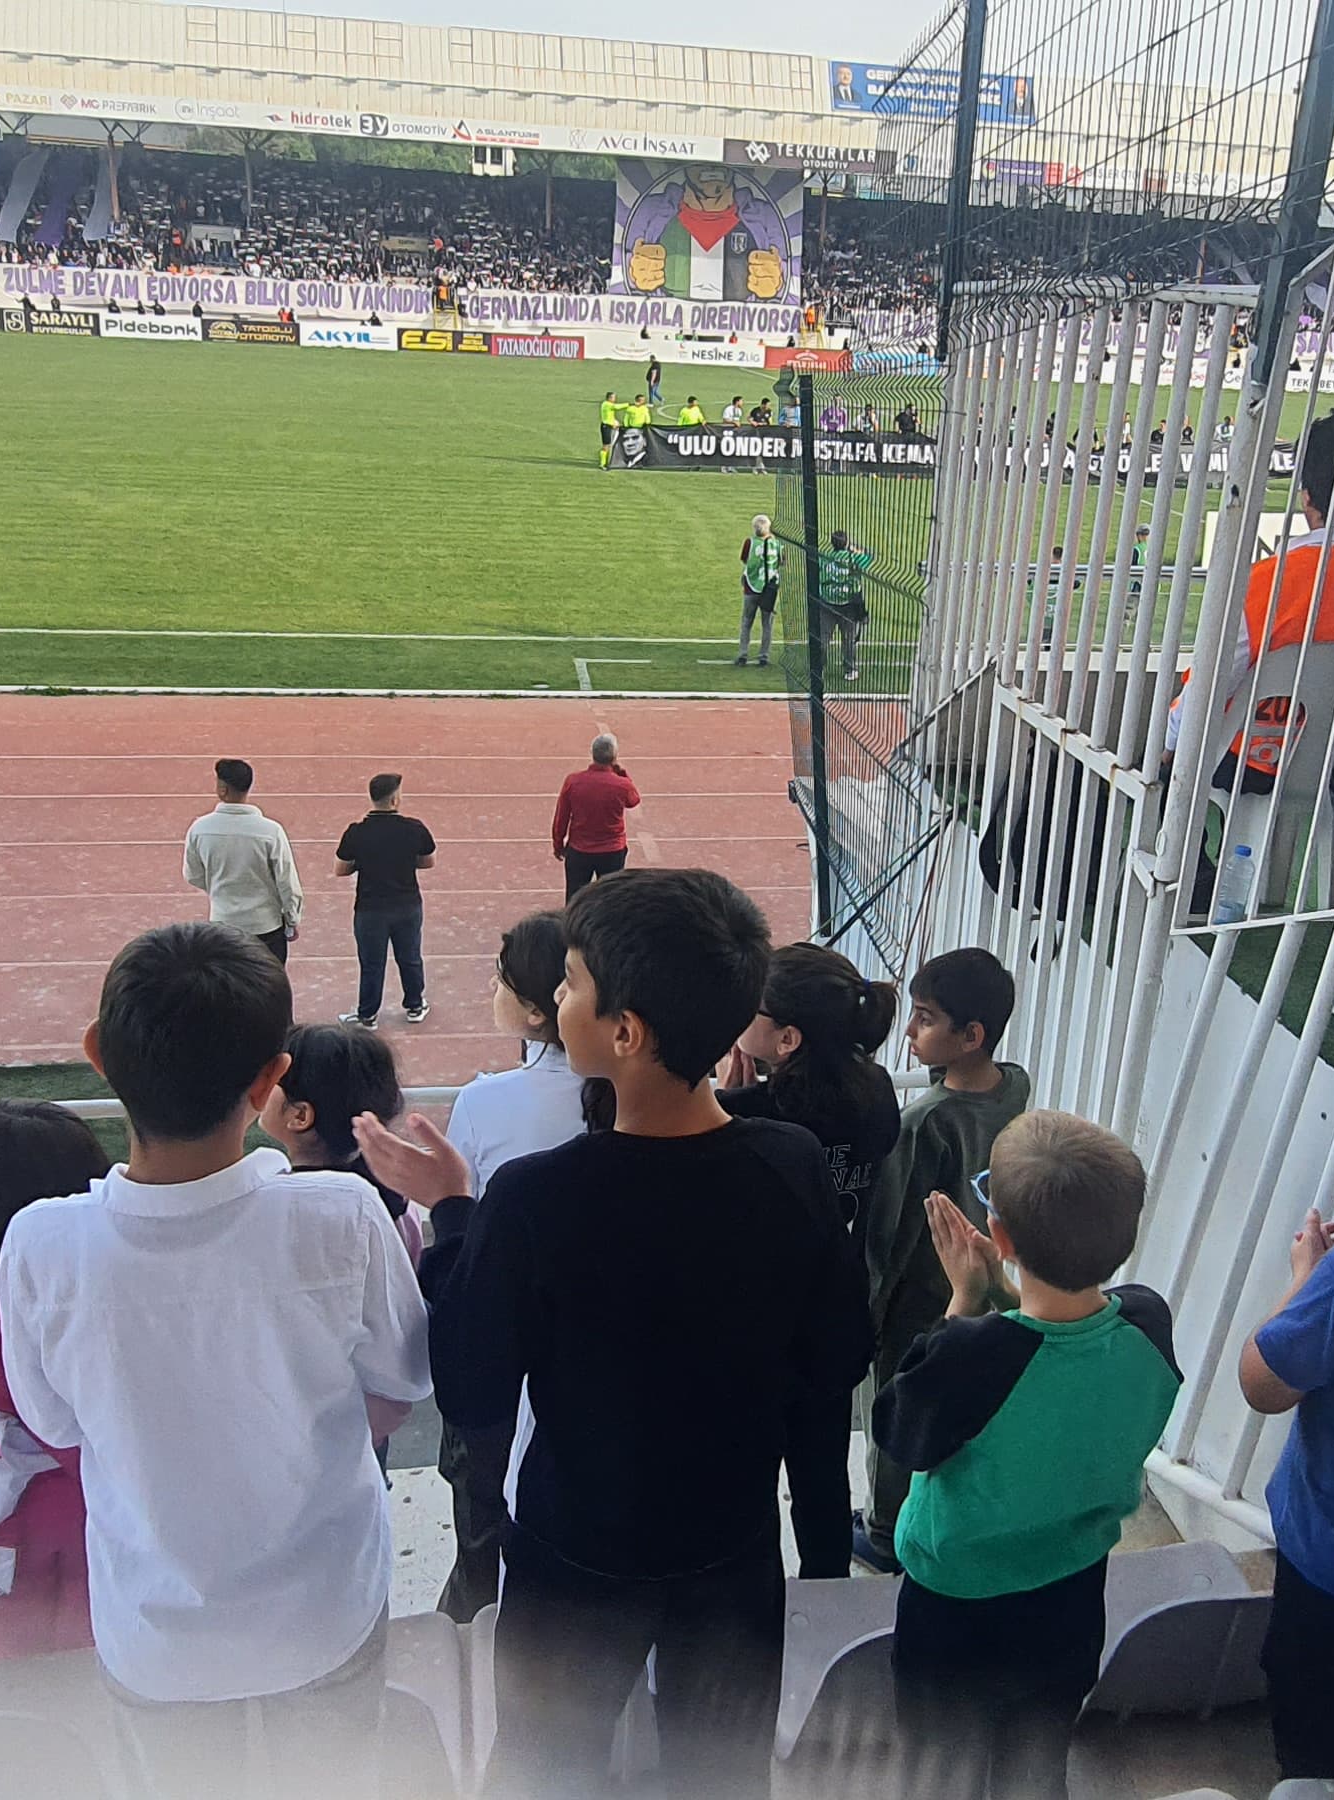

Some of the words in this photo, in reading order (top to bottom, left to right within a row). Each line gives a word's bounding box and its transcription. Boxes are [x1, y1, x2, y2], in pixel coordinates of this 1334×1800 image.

[290, 110, 352, 128] hidrotek
[643, 131, 696, 155] İNŞAAT
[776, 143, 876, 163] TEKKURTLAR
[2, 266, 66, 295] ZULME
[73, 270, 140, 300] DEVAM
[297, 282, 342, 309] SONU
[30, 311, 94, 327] SARAYLI
[553, 339, 580, 358] GRUP
[721, 431, 786, 458] ÖNDER
[882, 442, 939, 465] KEMA
